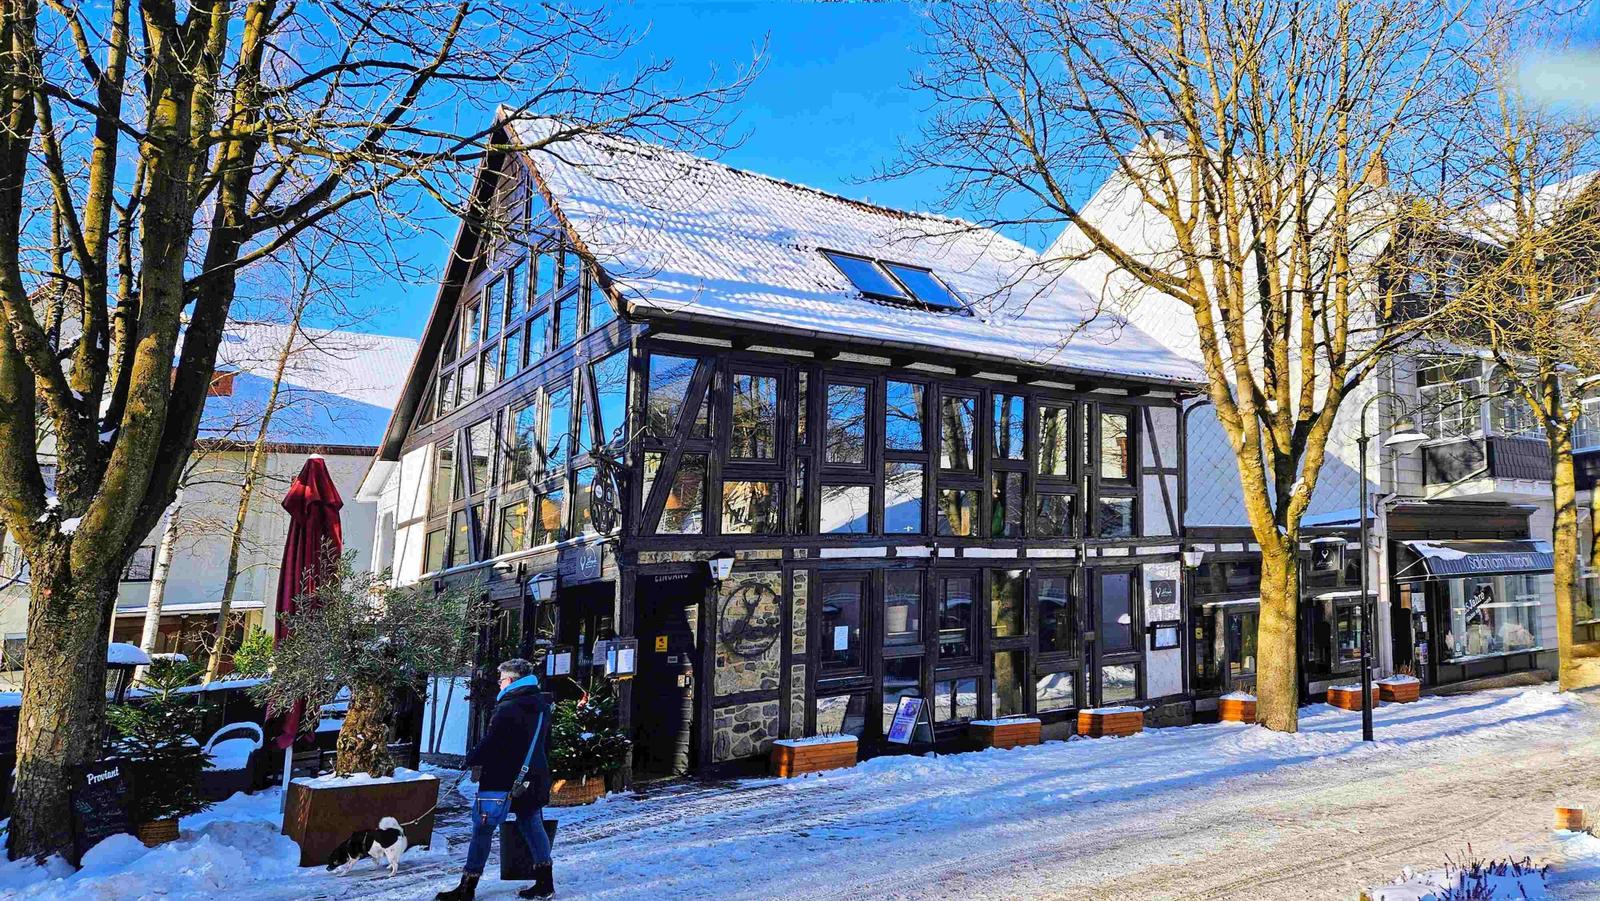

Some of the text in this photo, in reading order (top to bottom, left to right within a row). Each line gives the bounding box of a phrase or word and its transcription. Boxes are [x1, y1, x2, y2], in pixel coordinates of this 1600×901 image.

[1468, 556, 1491, 570] Salon
[1492, 557, 1506, 568] am
[86, 766, 120, 785] Proviant
